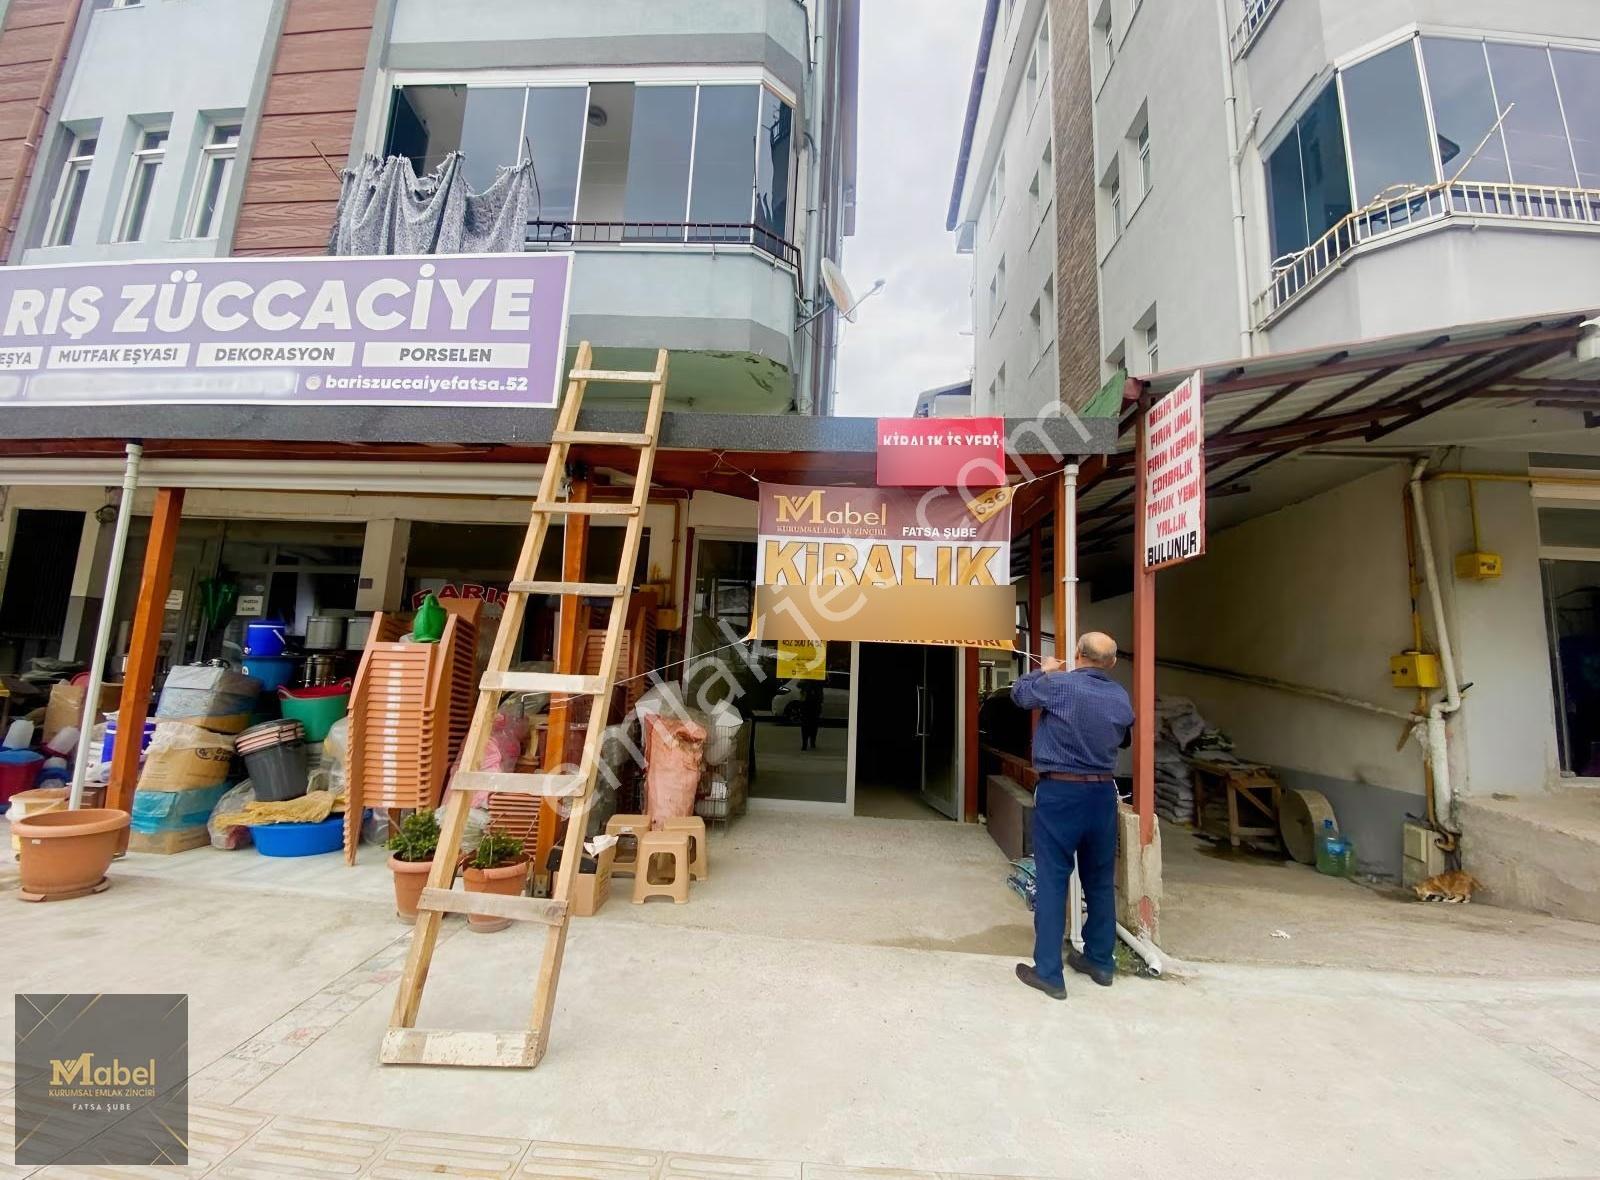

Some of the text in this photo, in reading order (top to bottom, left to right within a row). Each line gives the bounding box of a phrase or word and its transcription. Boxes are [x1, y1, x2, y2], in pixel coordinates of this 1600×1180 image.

[112, 264, 535, 333] ZÜCCACİYE
[58, 347, 178, 365] MUTFAK EŞYASI
[214, 347, 335, 362] DEKORASYON
[399, 347, 492, 362] PORSELEN
[325, 374, 528, 393] bariszuccaiyefatsa.52
[774, 489, 887, 525] Mabel
[902, 526, 977, 539] FATSA ŞUBE
[1147, 531, 1197, 567] BULUNUR
